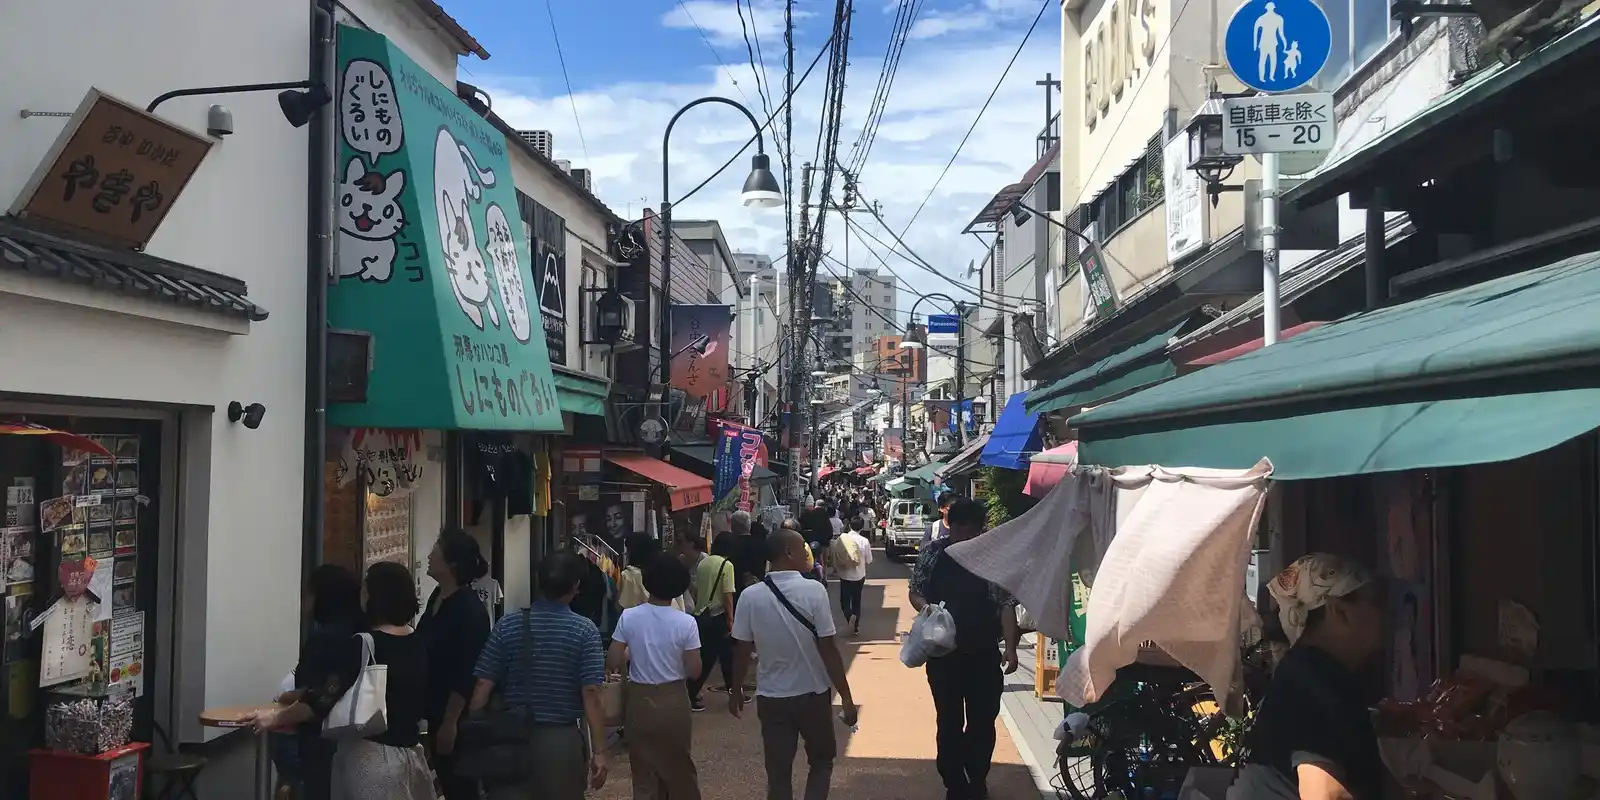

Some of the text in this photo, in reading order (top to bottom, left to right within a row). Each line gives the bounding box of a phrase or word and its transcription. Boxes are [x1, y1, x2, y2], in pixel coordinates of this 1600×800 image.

[349, 76, 369, 141] ぐるい
[369, 71, 392, 145] しにもの
[1230, 101, 1326, 124] 自転車を除く
[1236, 128, 1256, 147] 15
[1293, 125, 1321, 144] 20
[61, 155, 163, 224] やきや
[455, 364, 555, 418] しにものぐるい
